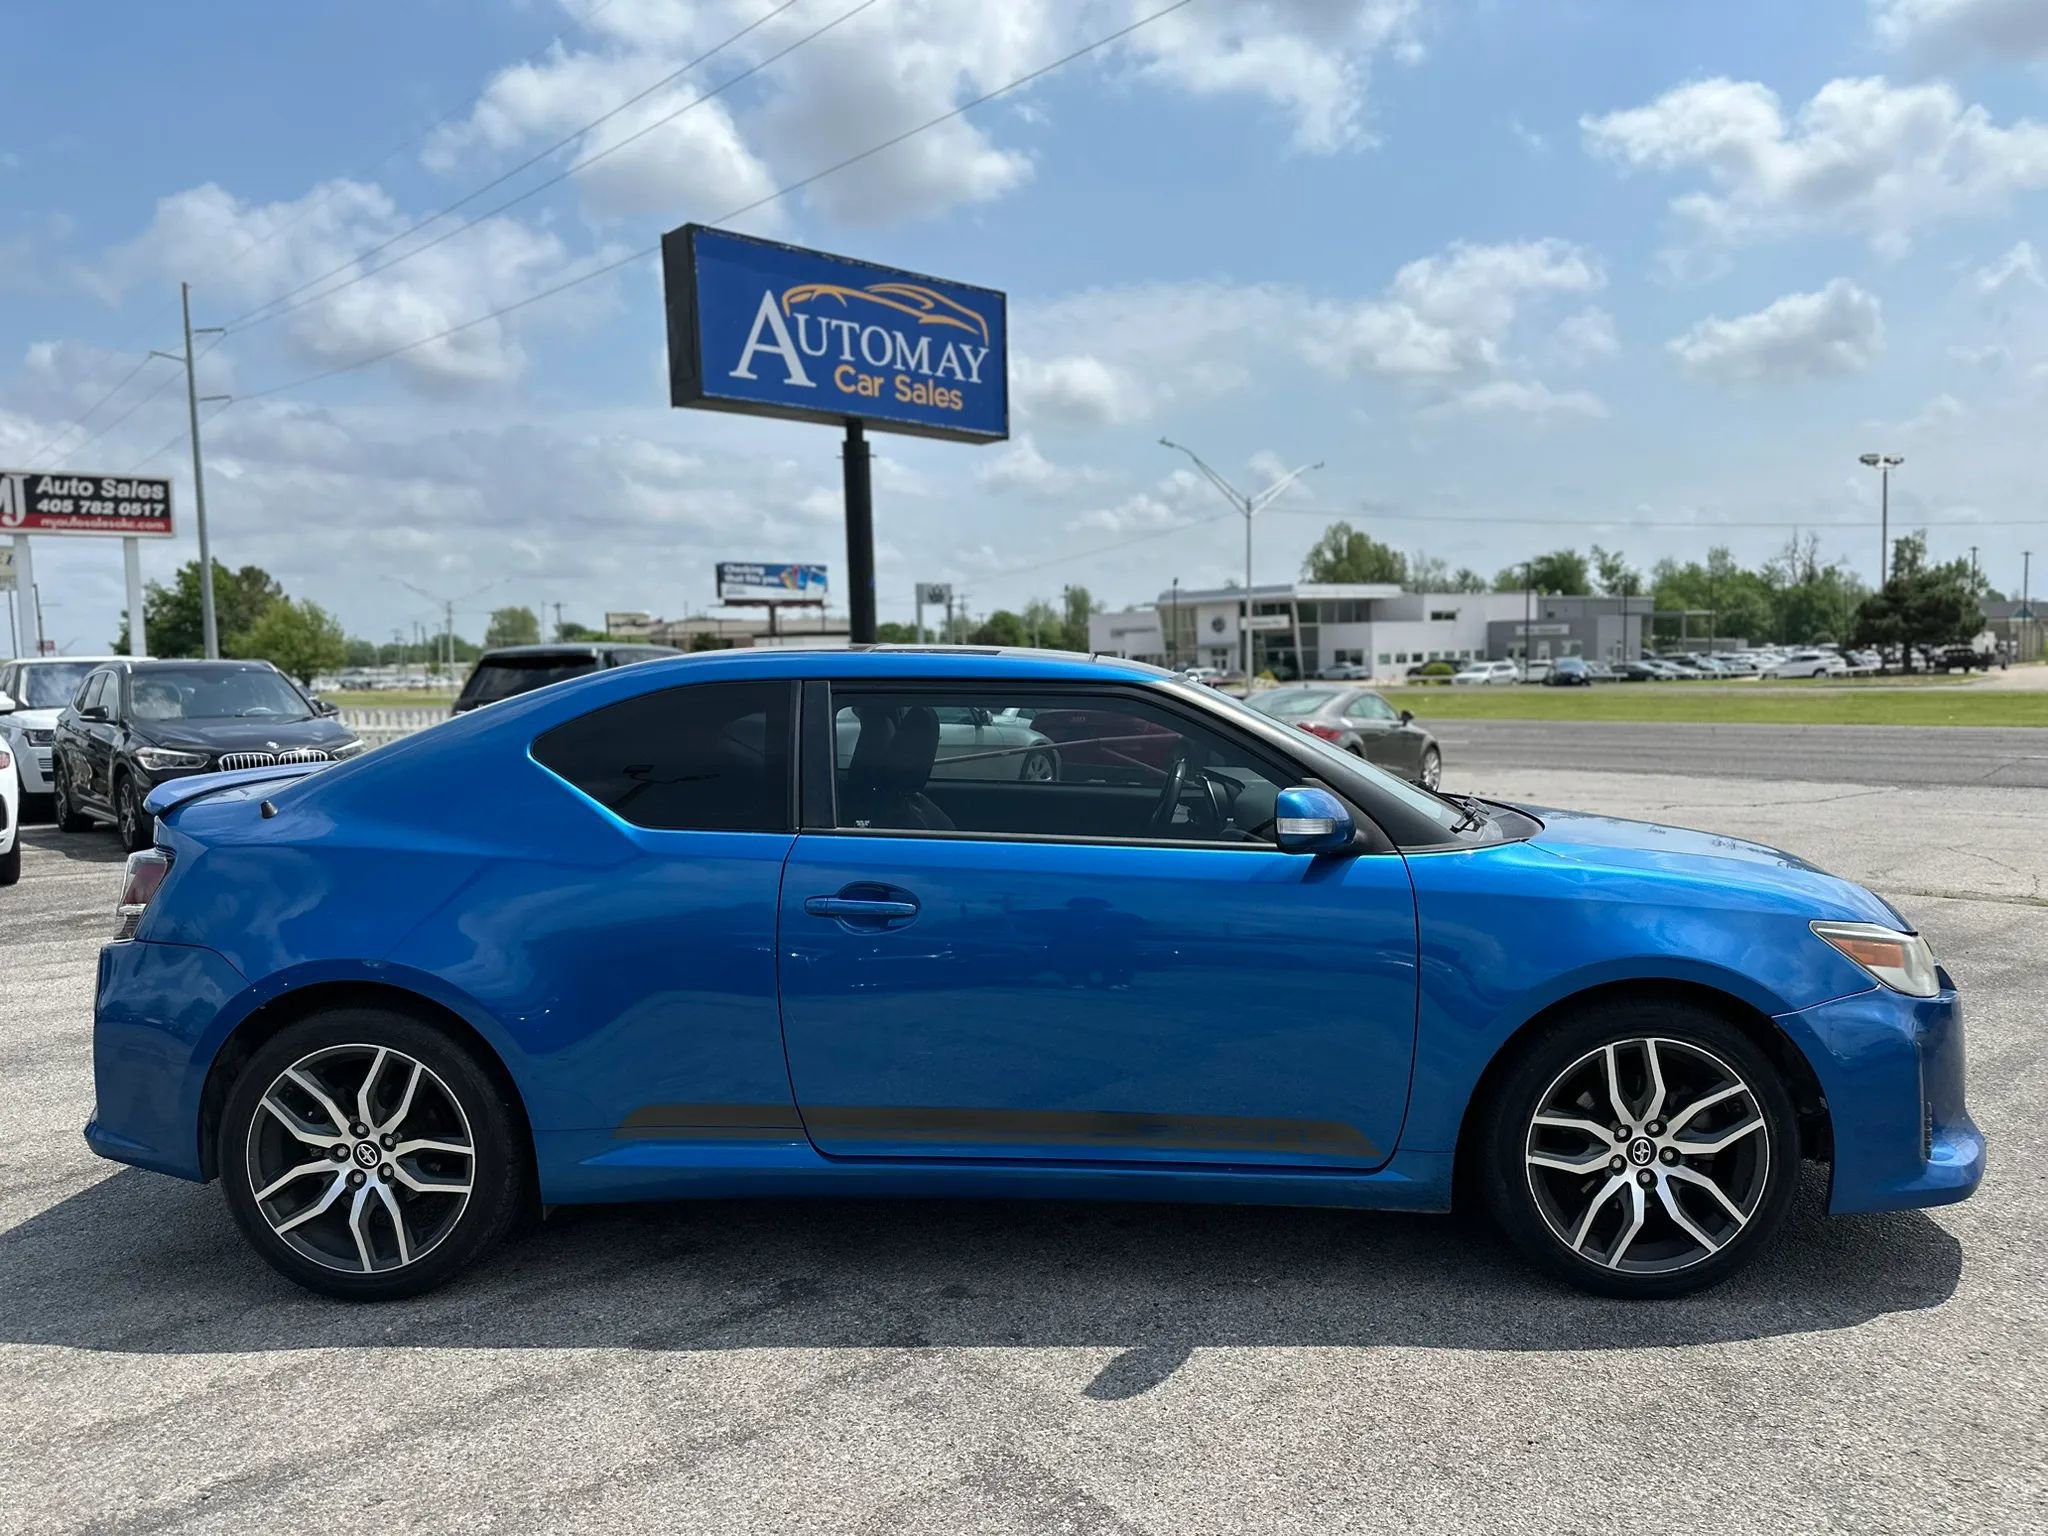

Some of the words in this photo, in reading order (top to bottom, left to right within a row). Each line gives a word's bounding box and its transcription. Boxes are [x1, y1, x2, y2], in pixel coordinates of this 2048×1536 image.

[729, 289, 989, 388] AUTOMAY
[834, 364, 885, 397] Car
[895, 374, 964, 411] Sales
[35, 475, 95, 497] Auto
[100, 478, 165, 500] Sales
[36, 498, 75, 514] 405
[79, 500, 115, 515] 782
[118, 502, 165, 517] 0517
